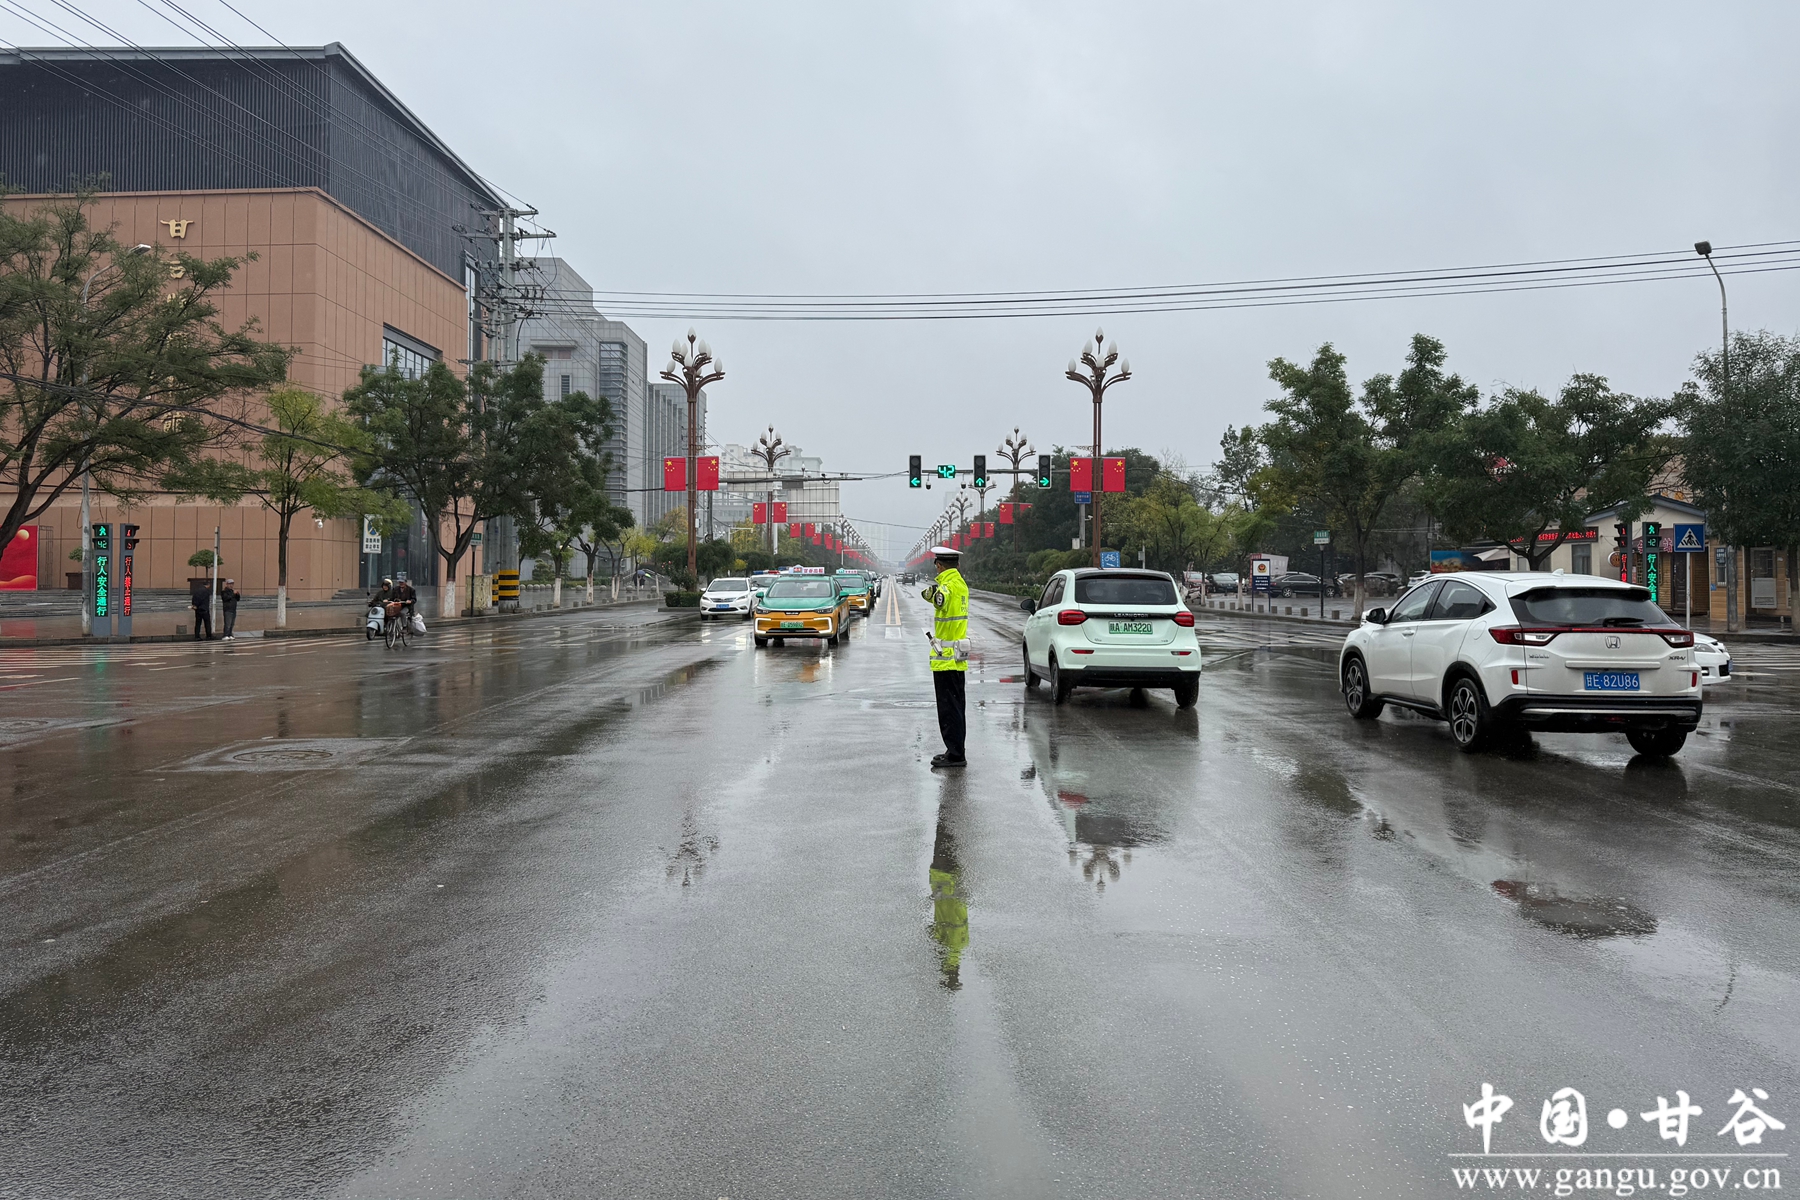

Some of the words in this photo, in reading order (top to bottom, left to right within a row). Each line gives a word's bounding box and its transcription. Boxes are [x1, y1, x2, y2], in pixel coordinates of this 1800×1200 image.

[938, 465, 955, 478] 42
[97, 540, 107, 549] 42
[97, 556, 107, 616] 行人安全通行
[123, 556, 132, 616] 行人禁止通行
